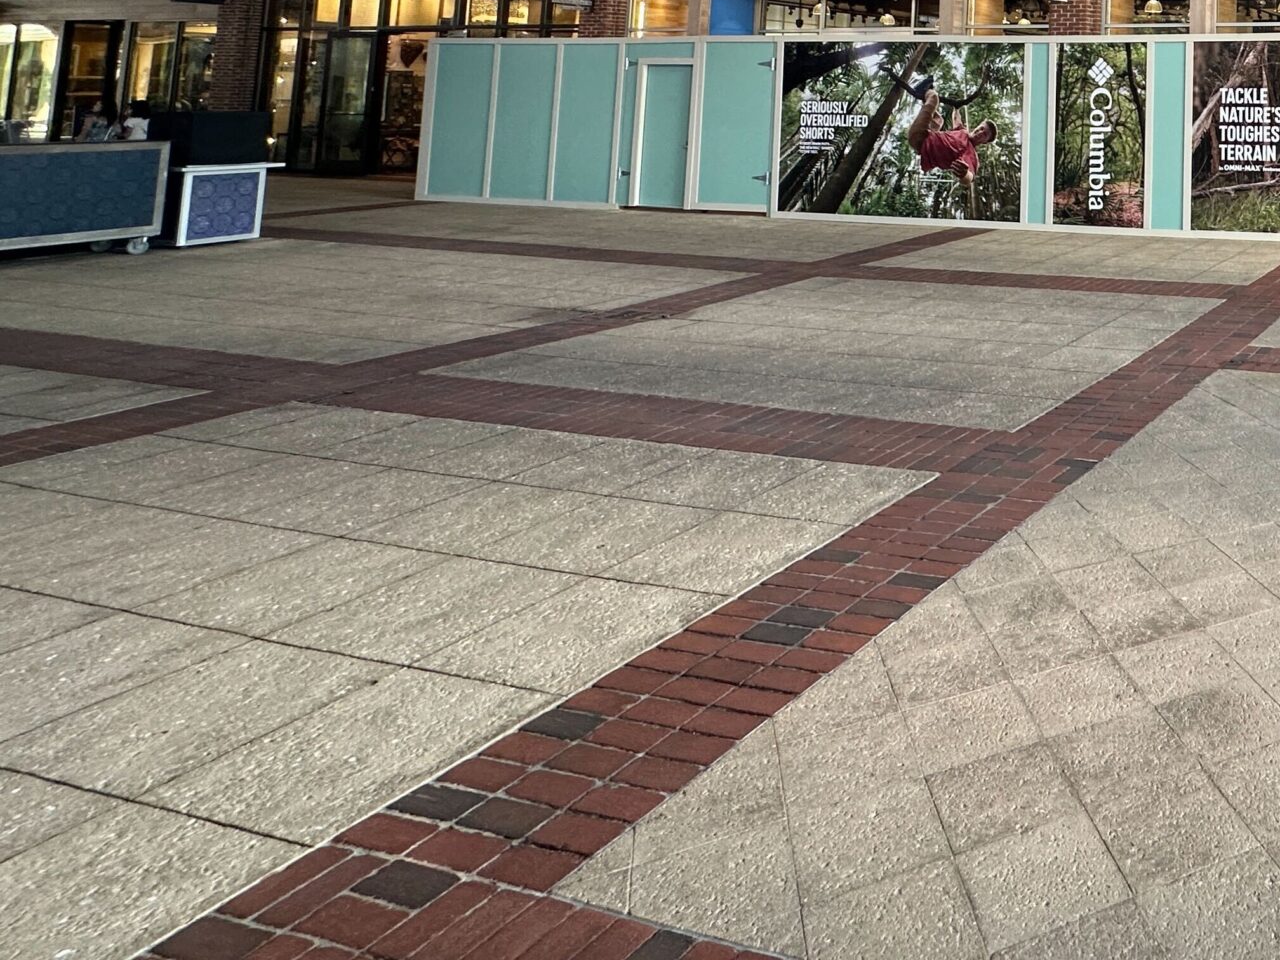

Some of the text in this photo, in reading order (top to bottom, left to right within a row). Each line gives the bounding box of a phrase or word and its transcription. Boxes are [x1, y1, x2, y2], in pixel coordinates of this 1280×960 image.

[1219, 87, 1268, 104] TACKLE
[800, 101, 848, 114] SERIOUSLY
[800, 113, 869, 127] OVERQUALIFIED
[799, 127, 835, 140] SHORTS
[1088, 87, 1113, 211] Columbia
[1218, 144, 1277, 162] TERRAIN
